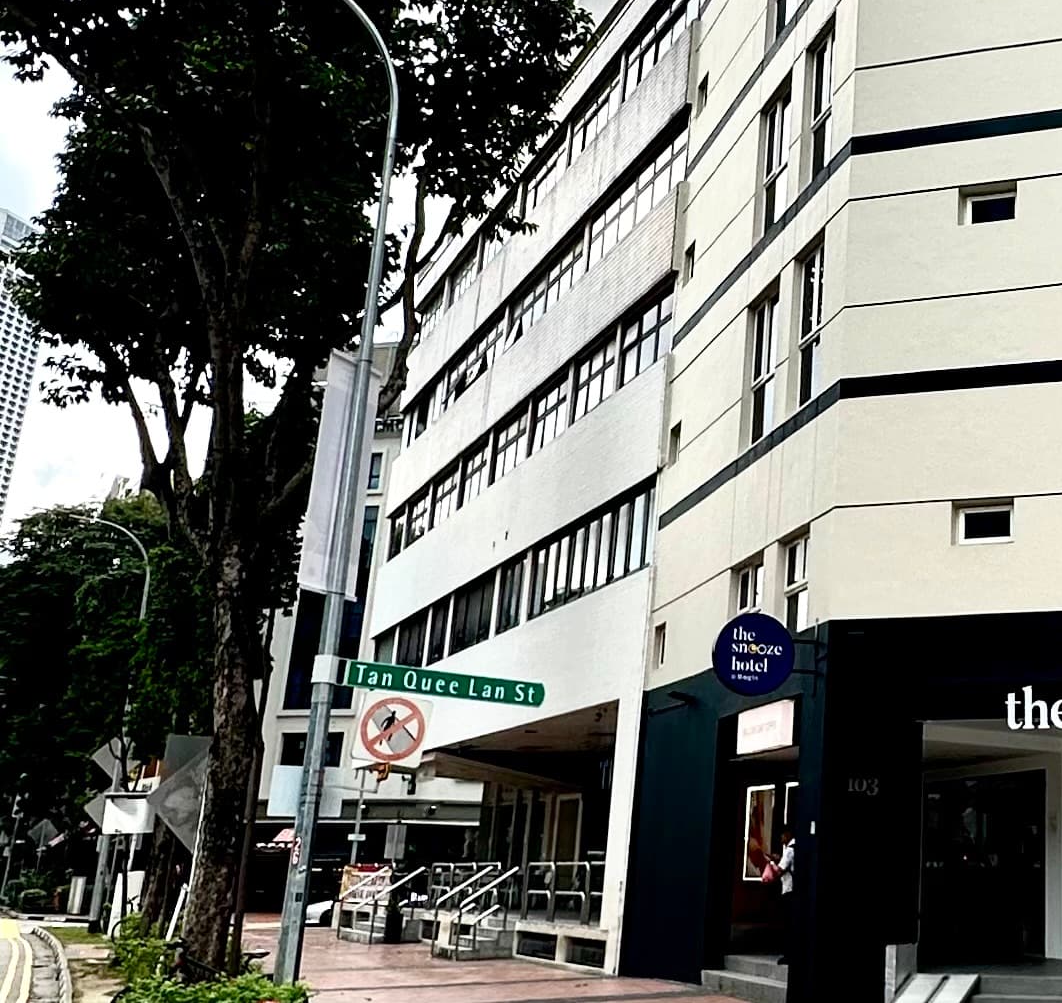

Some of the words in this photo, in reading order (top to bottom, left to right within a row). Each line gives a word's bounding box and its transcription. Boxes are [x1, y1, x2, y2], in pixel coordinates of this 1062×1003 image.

[733, 626, 756, 642] the
[731, 642, 783, 656] snooze
[731, 655, 768, 673] hotel
[355, 664, 393, 687] Tan
[403, 670, 459, 694] Quee
[469, 678, 505, 700] Lan
[514, 684, 535, 703] St
[847, 778, 879, 796] 103
